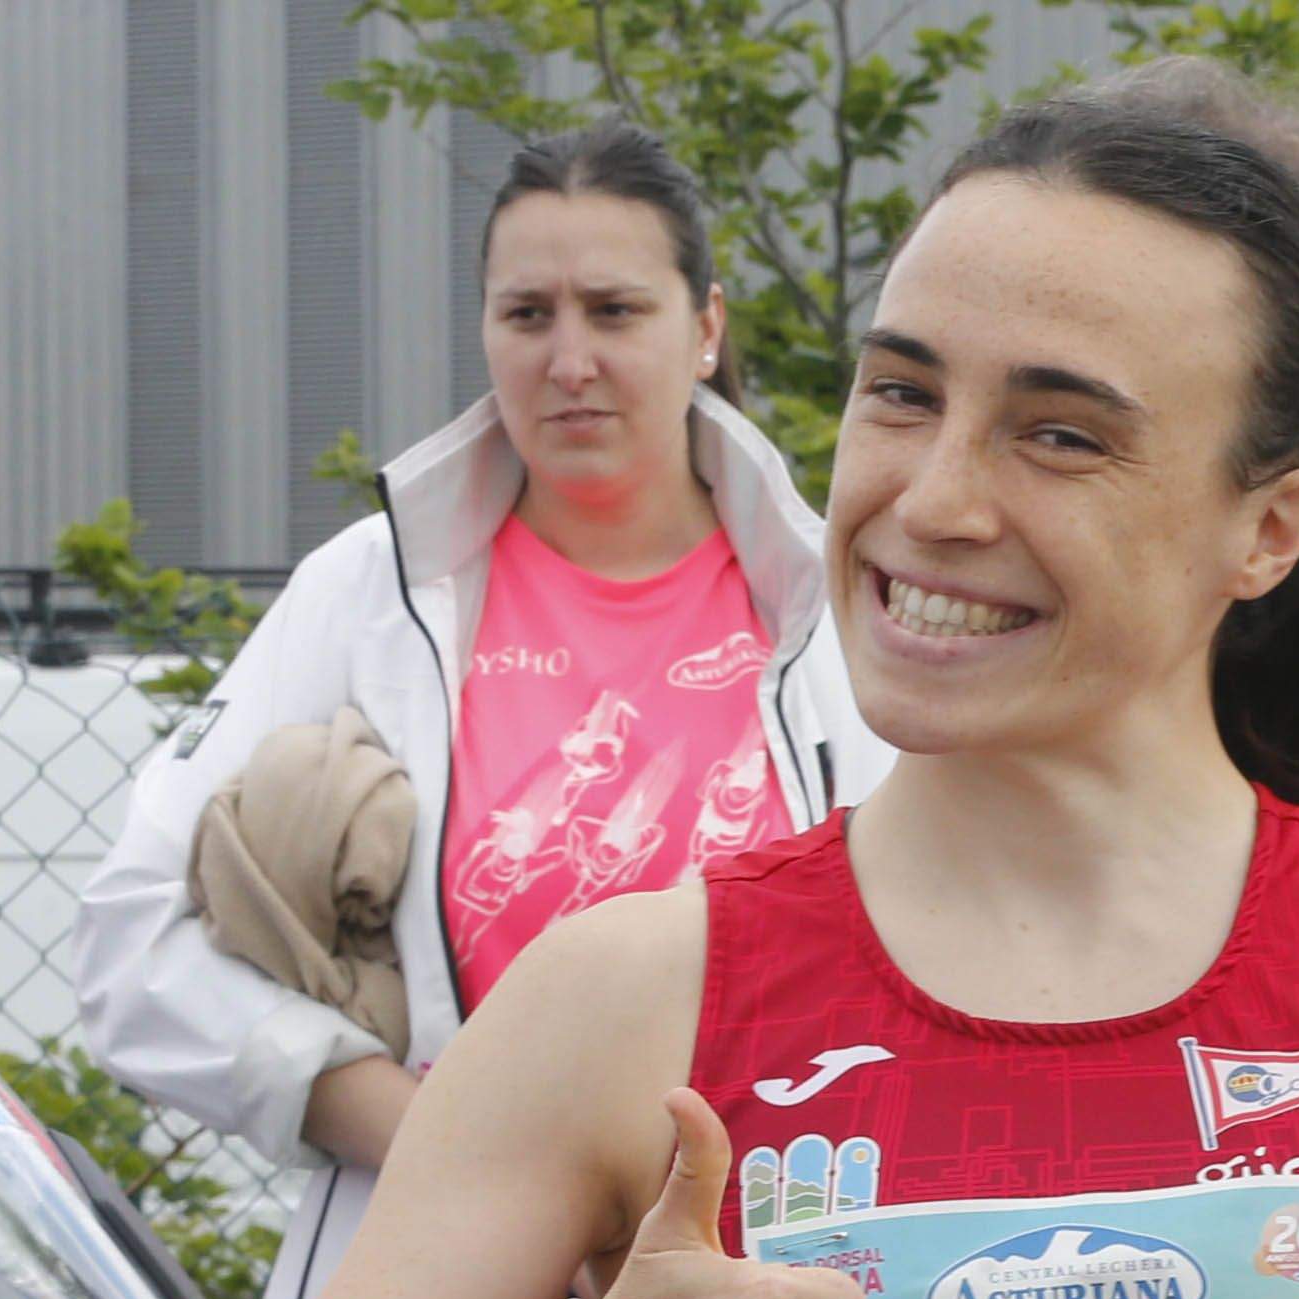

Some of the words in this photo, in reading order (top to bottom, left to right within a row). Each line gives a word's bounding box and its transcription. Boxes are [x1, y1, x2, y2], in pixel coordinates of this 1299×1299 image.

[470, 645, 571, 678] YSHO
[988, 1265, 1078, 1284] CENTRAL
[1086, 1258, 1177, 1275] LECHERA
